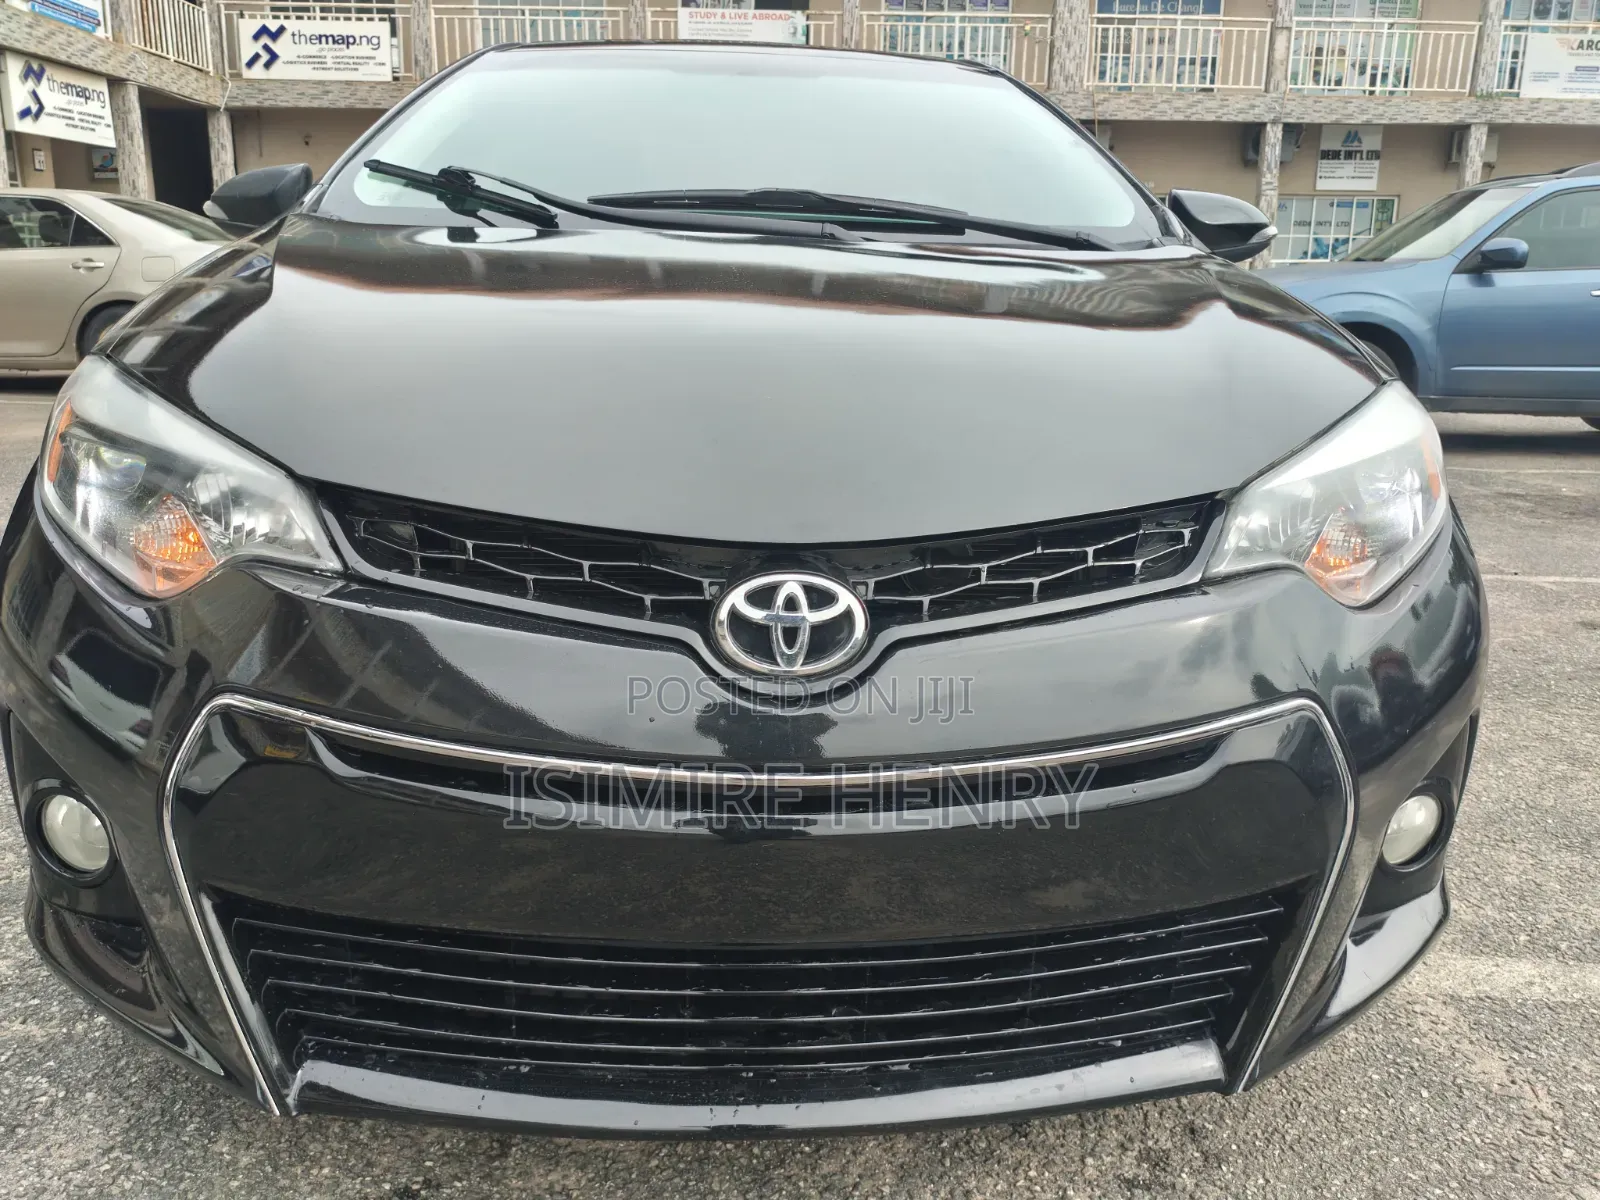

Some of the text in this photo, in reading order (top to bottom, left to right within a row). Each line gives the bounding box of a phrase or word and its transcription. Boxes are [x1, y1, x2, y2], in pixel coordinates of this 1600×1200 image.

[688, 11, 791, 21] STUDY & LIVE ABROAD
[291, 30, 381, 50] themap.ng
[47, 73, 106, 109] themap.ng
[1320, 150, 1342, 161] DEDE
